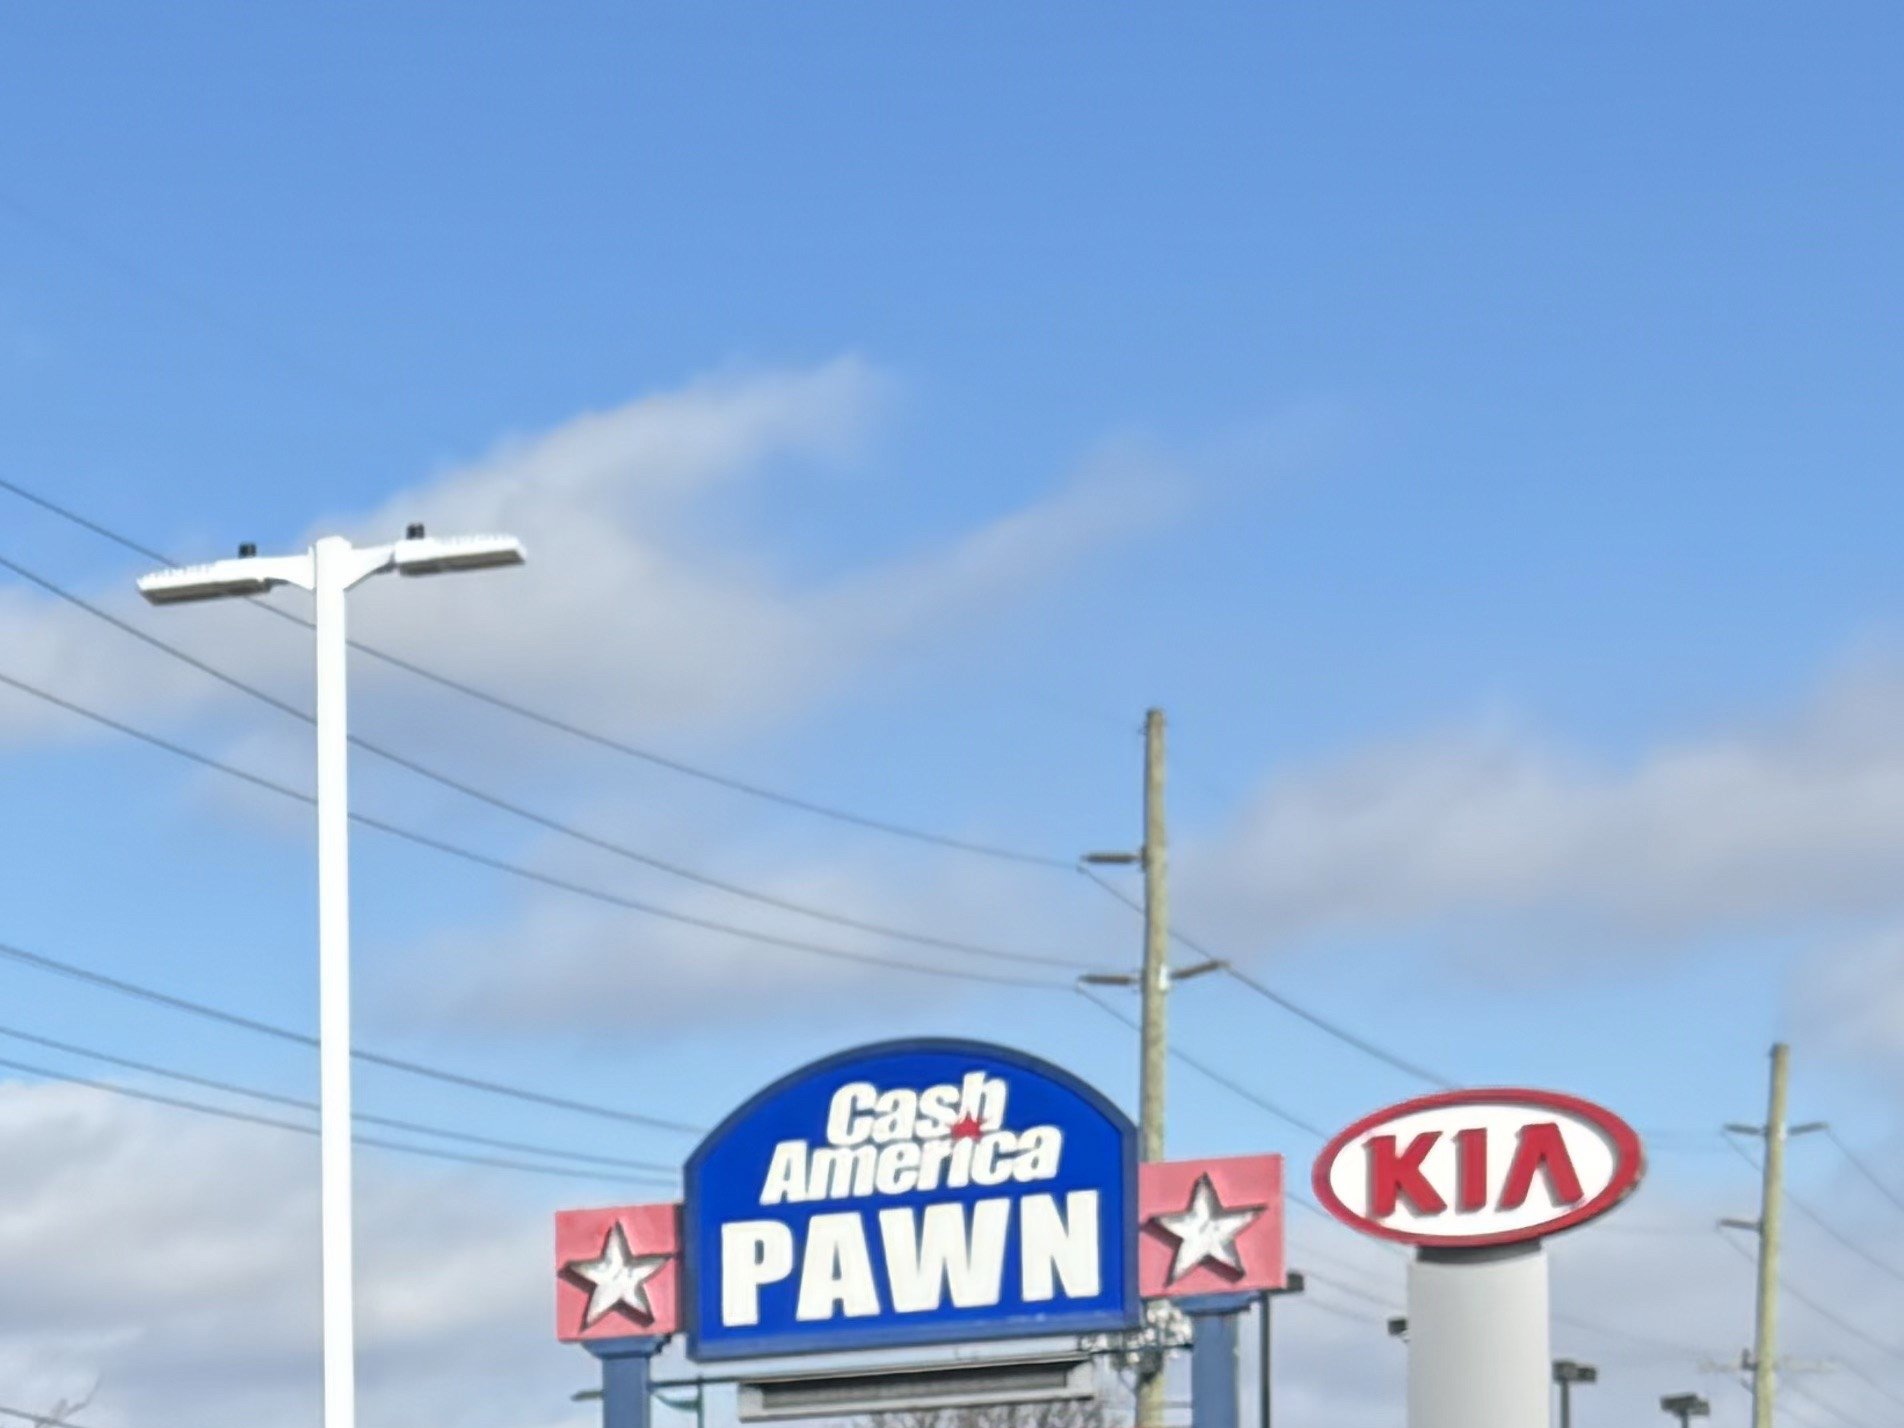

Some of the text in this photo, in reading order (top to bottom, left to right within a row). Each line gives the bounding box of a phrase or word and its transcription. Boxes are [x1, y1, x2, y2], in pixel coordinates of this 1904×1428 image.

[825, 1069, 1008, 1146] Cash
[759, 1124, 1063, 1206] America
[1363, 1121, 1585, 1219] KIA
[720, 1188, 1101, 1328] PAWN
